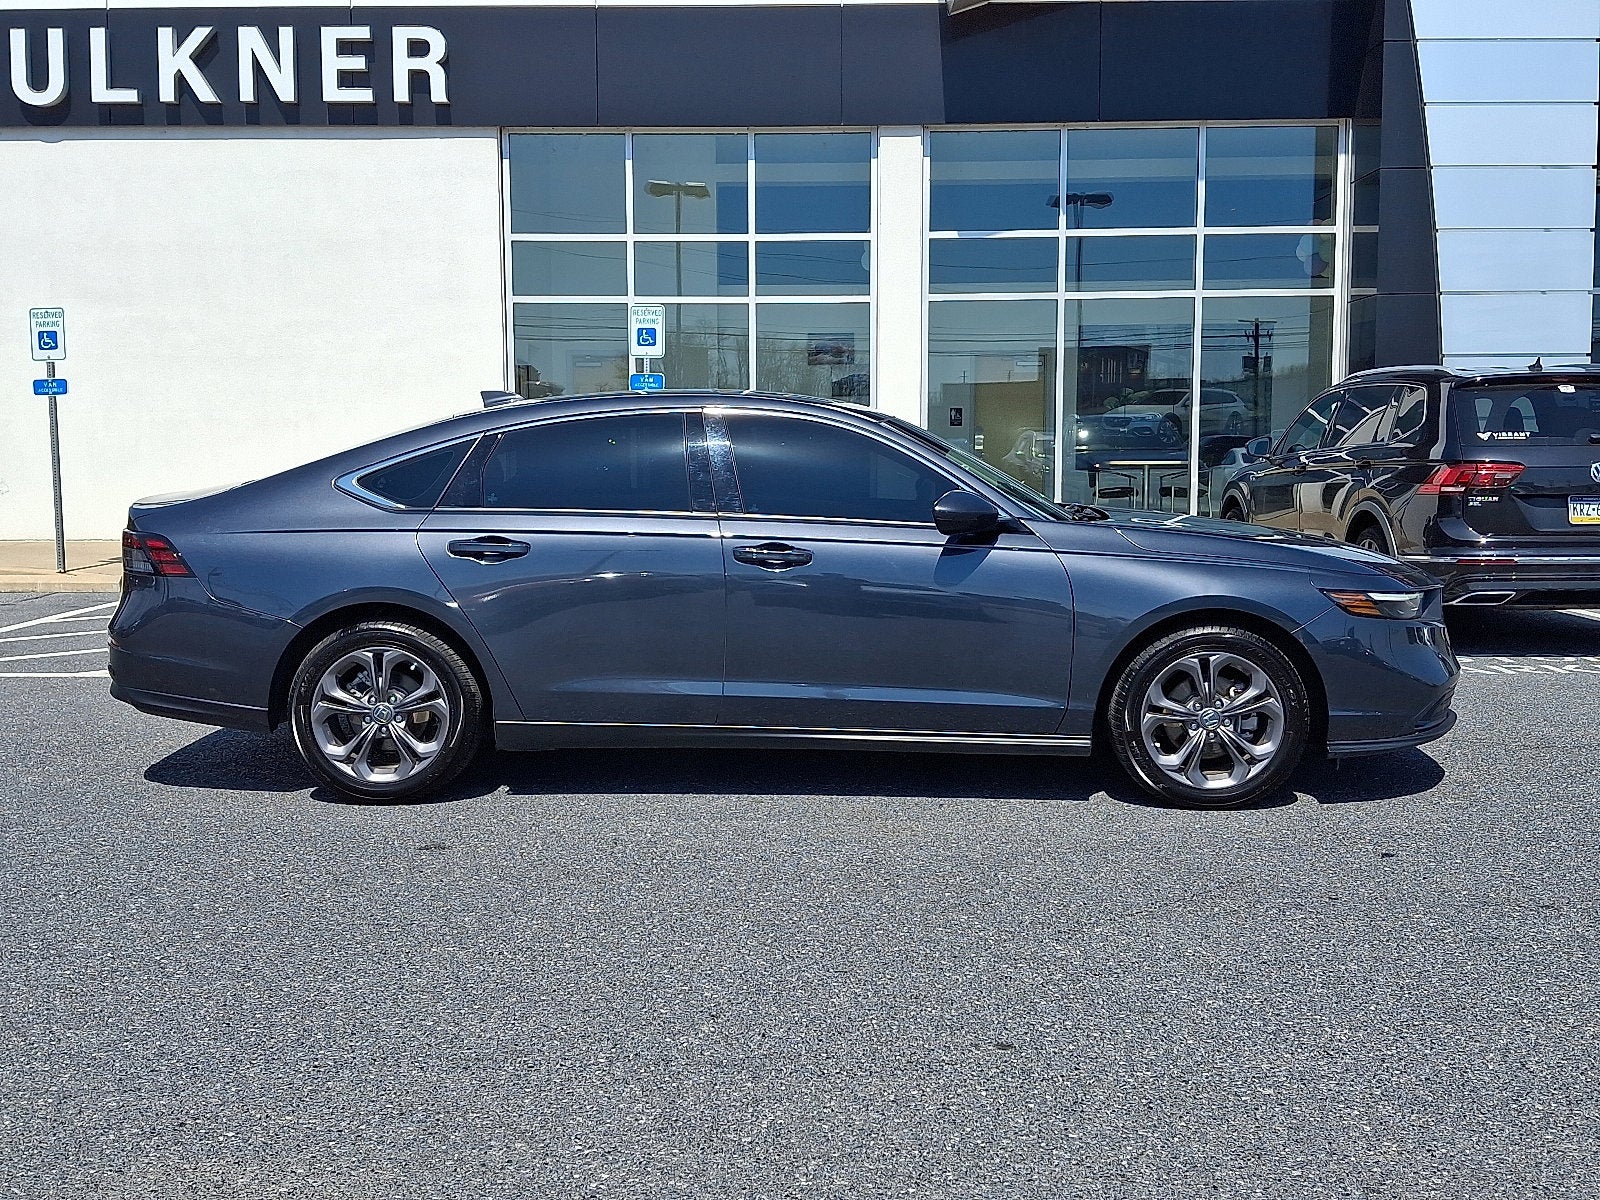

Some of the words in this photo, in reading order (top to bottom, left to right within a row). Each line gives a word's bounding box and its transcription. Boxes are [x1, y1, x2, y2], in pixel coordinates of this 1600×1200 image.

[9, 25, 449, 106] ULKNER
[32, 311, 62, 319] RESERVED
[632, 309, 663, 317] RESERVED
[35, 320, 60, 328] PARKING
[635, 317, 660, 325] PARKING
[1492, 432, 1531, 440] VIBRANT
